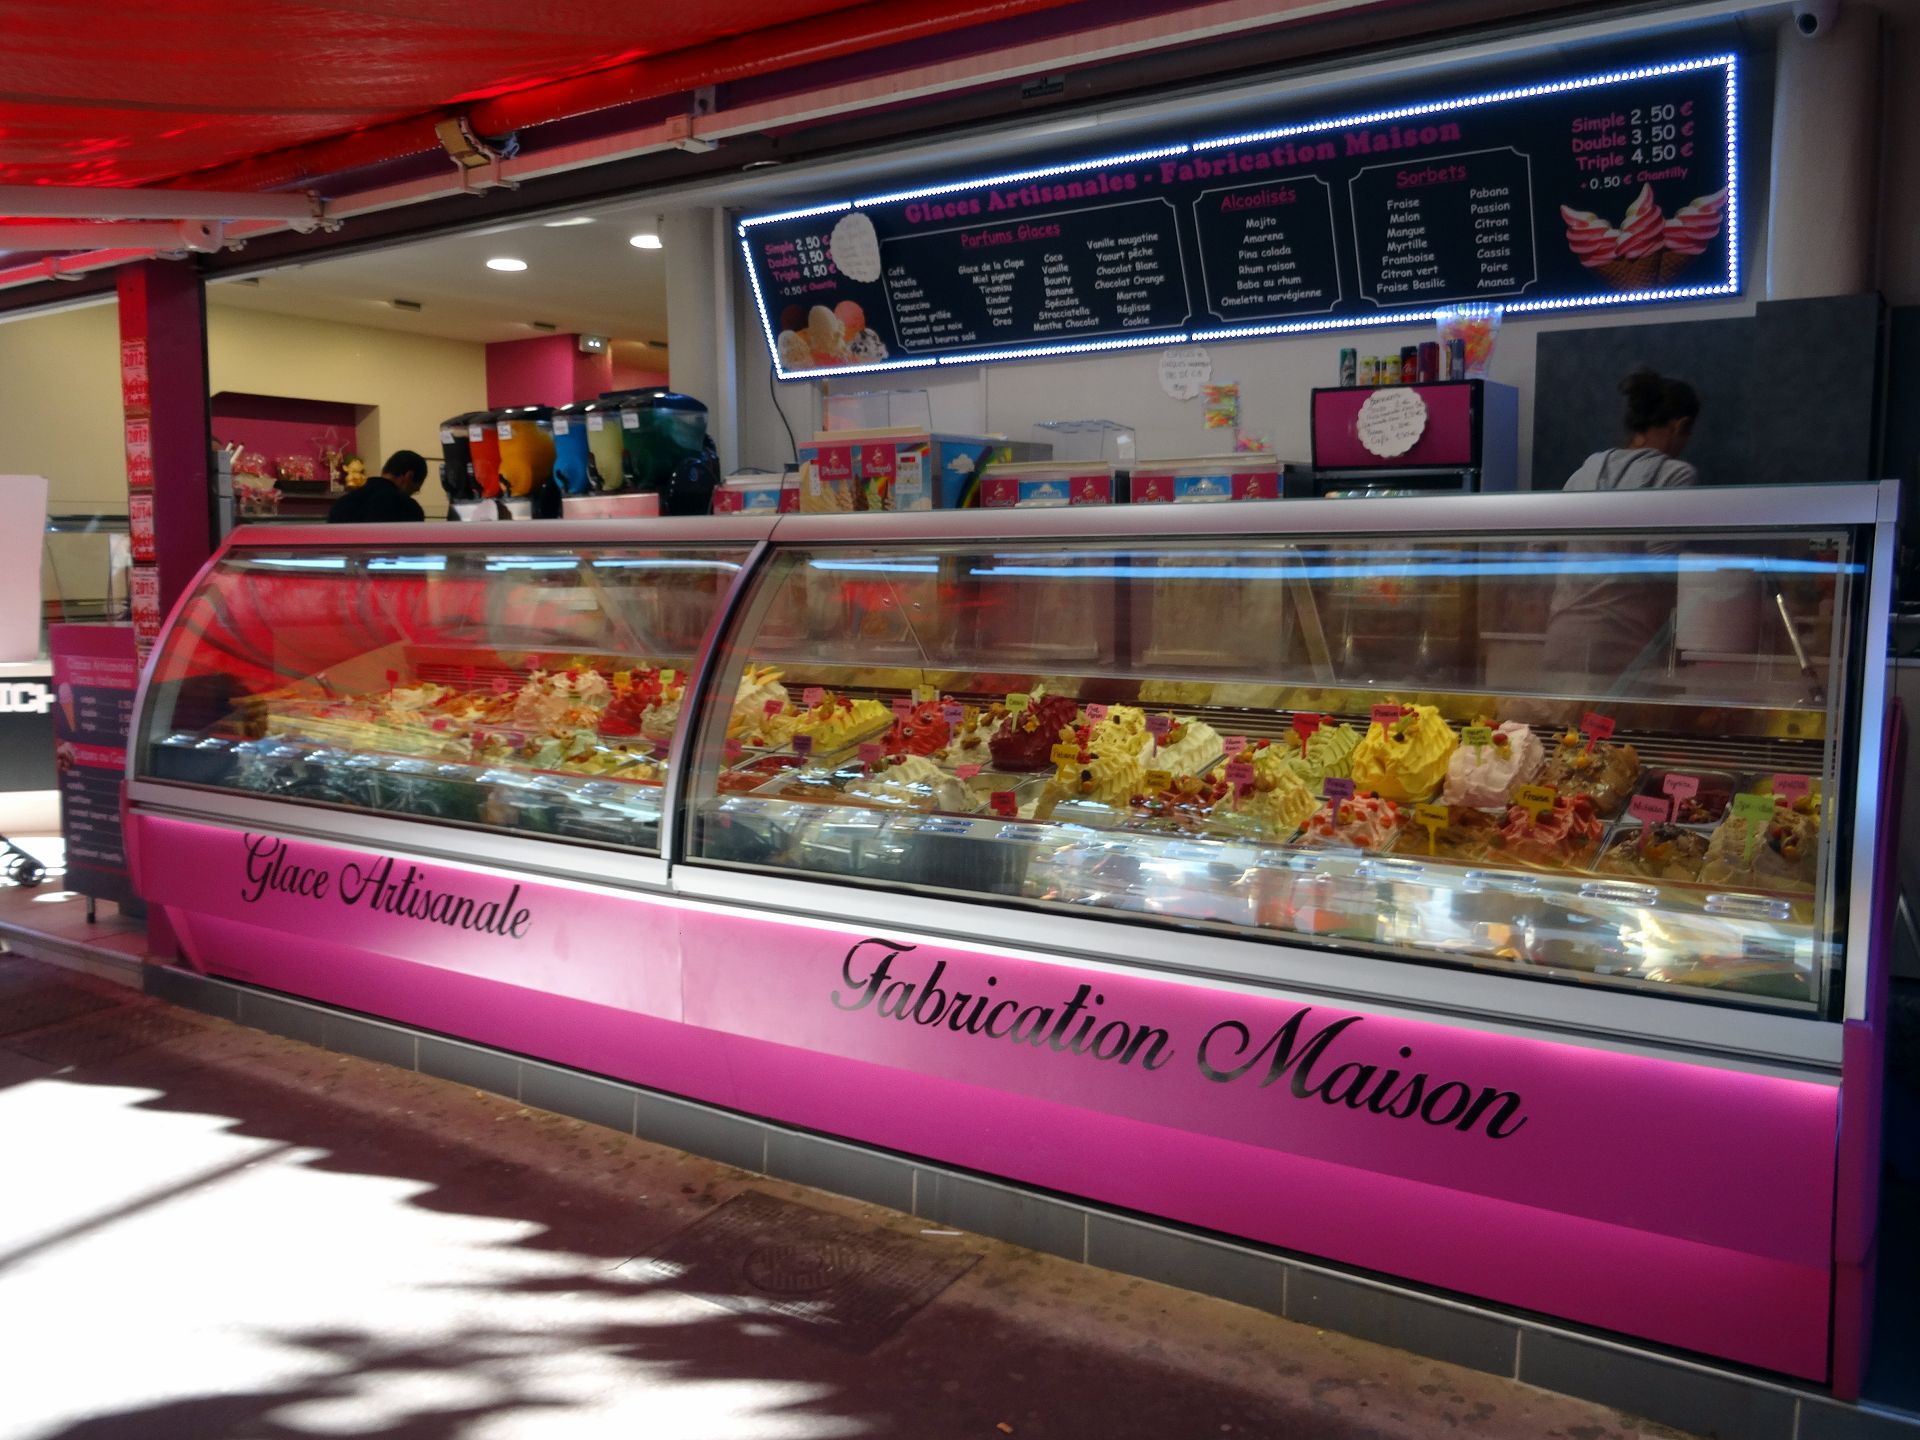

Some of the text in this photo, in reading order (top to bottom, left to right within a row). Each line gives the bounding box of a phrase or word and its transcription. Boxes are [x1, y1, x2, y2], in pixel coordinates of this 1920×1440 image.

[1572, 101, 1694, 132] Simple 2.50 €
[1572, 121, 1694, 153] Double 3.50 €
[1575, 142, 1694, 171] Triple 4.50 €
[904, 196, 981, 224] Glaces
[988, 171, 1137, 211] Artisanales
[1159, 140, 1337, 184] Fabrication
[1345, 122, 1461, 156] Maison
[1397, 164, 1467, 185] Sorbets
[1637, 166, 1688, 182] Chantilly
[1220, 187, 1296, 210] Alcoolisés
[1470, 186, 1509, 199] Pabana
[1387, 198, 1420, 210] Fraise
[1470, 201, 1511, 214] Passion
[1246, 216, 1277, 230] Mojito
[1390, 212, 1420, 224] Melon
[1474, 216, 1509, 229] Citron
[960, 222, 1061, 249] Parfums Glaces
[1243, 232, 1284, 244] Amarena
[1387, 225, 1425, 240] Mangue
[1475, 231, 1510, 244] Cerise
[764, 241, 794, 254] Simple
[795, 235, 821, 251] 2.50
[1086, 233, 1159, 249] Vanille nougatine
[1387, 238, 1428, 253] Myrtille
[767, 255, 798, 268] Double
[799, 250, 825, 264] 3.50
[1044, 253, 1063, 263] Coco
[1096, 247, 1153, 262] Yaourt pêche
[1238, 246, 1291, 260] Pina colada
[1382, 251, 1435, 266] Framboise
[1476, 245, 1511, 259] Cassis
[772, 268, 801, 282] Triple
[803, 264, 828, 278] 4.50
[887, 266, 905, 276] Café
[958, 259, 1024, 275] Glace de la Clape
[1042, 264, 1069, 274] Vanille
[1096, 261, 1158, 276] Chocolat Blanc
[1238, 265, 1264, 275] Rhum
[1381, 264, 1439, 279] Citron vert
[1480, 261, 1509, 273] Poire
[890, 277, 917, 288] Nutella
[972, 272, 1015, 284] Miel pignon
[1043, 275, 1071, 286] Bounty
[1094, 275, 1165, 289] Chocolat Orange
[1237, 275, 1301, 290] Baba au rhum
[1476, 276, 1515, 288] Ananas
[979, 284, 1012, 294] Tiramisu
[1045, 287, 1074, 297] Banane
[1377, 278, 1446, 293] Fraise Basilic
[893, 289, 924, 300] Chocolat
[985, 295, 1010, 305] Kinder
[1116, 290, 1147, 301] Marron
[1221, 288, 1322, 307] Omelette norvégienne
[987, 306, 1013, 316] Yaourt
[1039, 306, 1090, 320] Stracciatella
[1117, 303, 1151, 315] Réglisse
[899, 310, 952, 323] Amande grillée
[992, 317, 1012, 327] Oreo
[1122, 316, 1150, 326] Cookie
[902, 324, 930, 335] Caramel
[947, 321, 963, 331] noix
[1033, 317, 1100, 332] Menthe Chocolat
[904, 331, 976, 347] Caramel beurre salé
[241, 832, 532, 939] Glace Artisanale
[831, 937, 1528, 1140] Fabrication Maison
